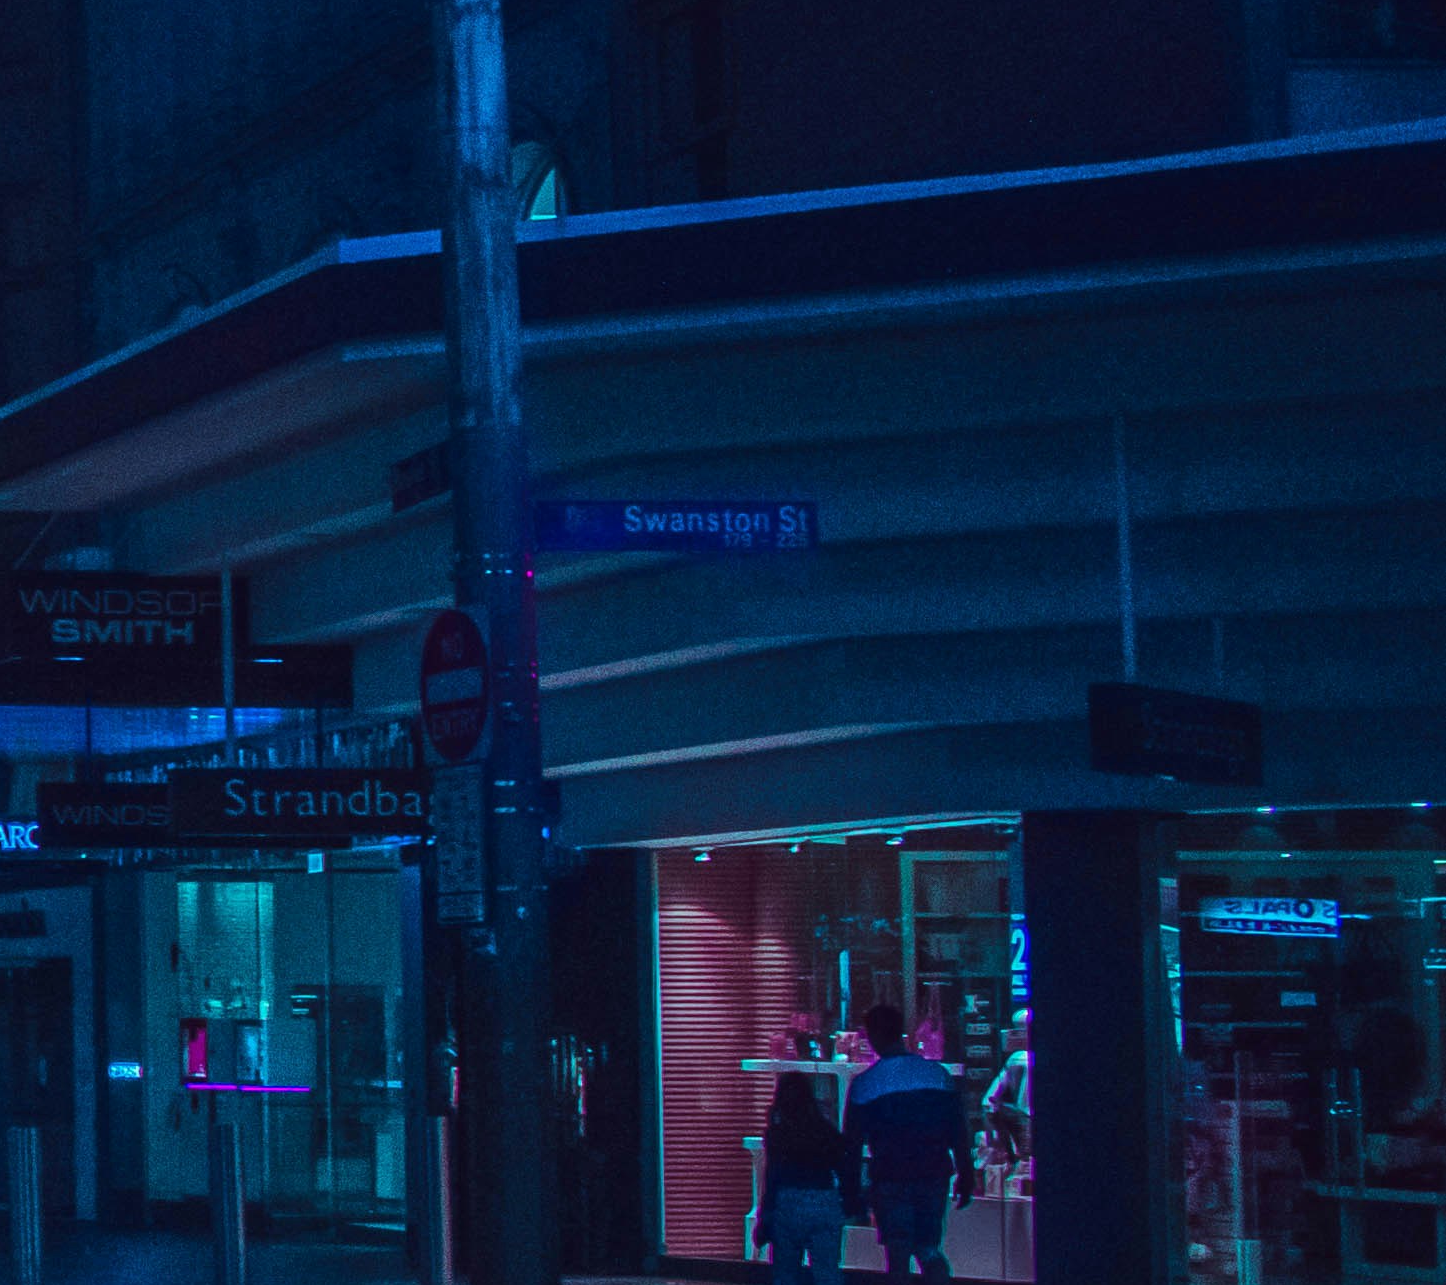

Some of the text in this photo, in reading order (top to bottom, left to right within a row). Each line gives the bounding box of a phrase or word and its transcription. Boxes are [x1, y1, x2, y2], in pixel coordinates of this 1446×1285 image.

[623, 504, 808, 532] Swanston St
[52, 618, 194, 645] SMITH
[224, 778, 437, 821] Strandba
[52, 805, 172, 826] WINDS
